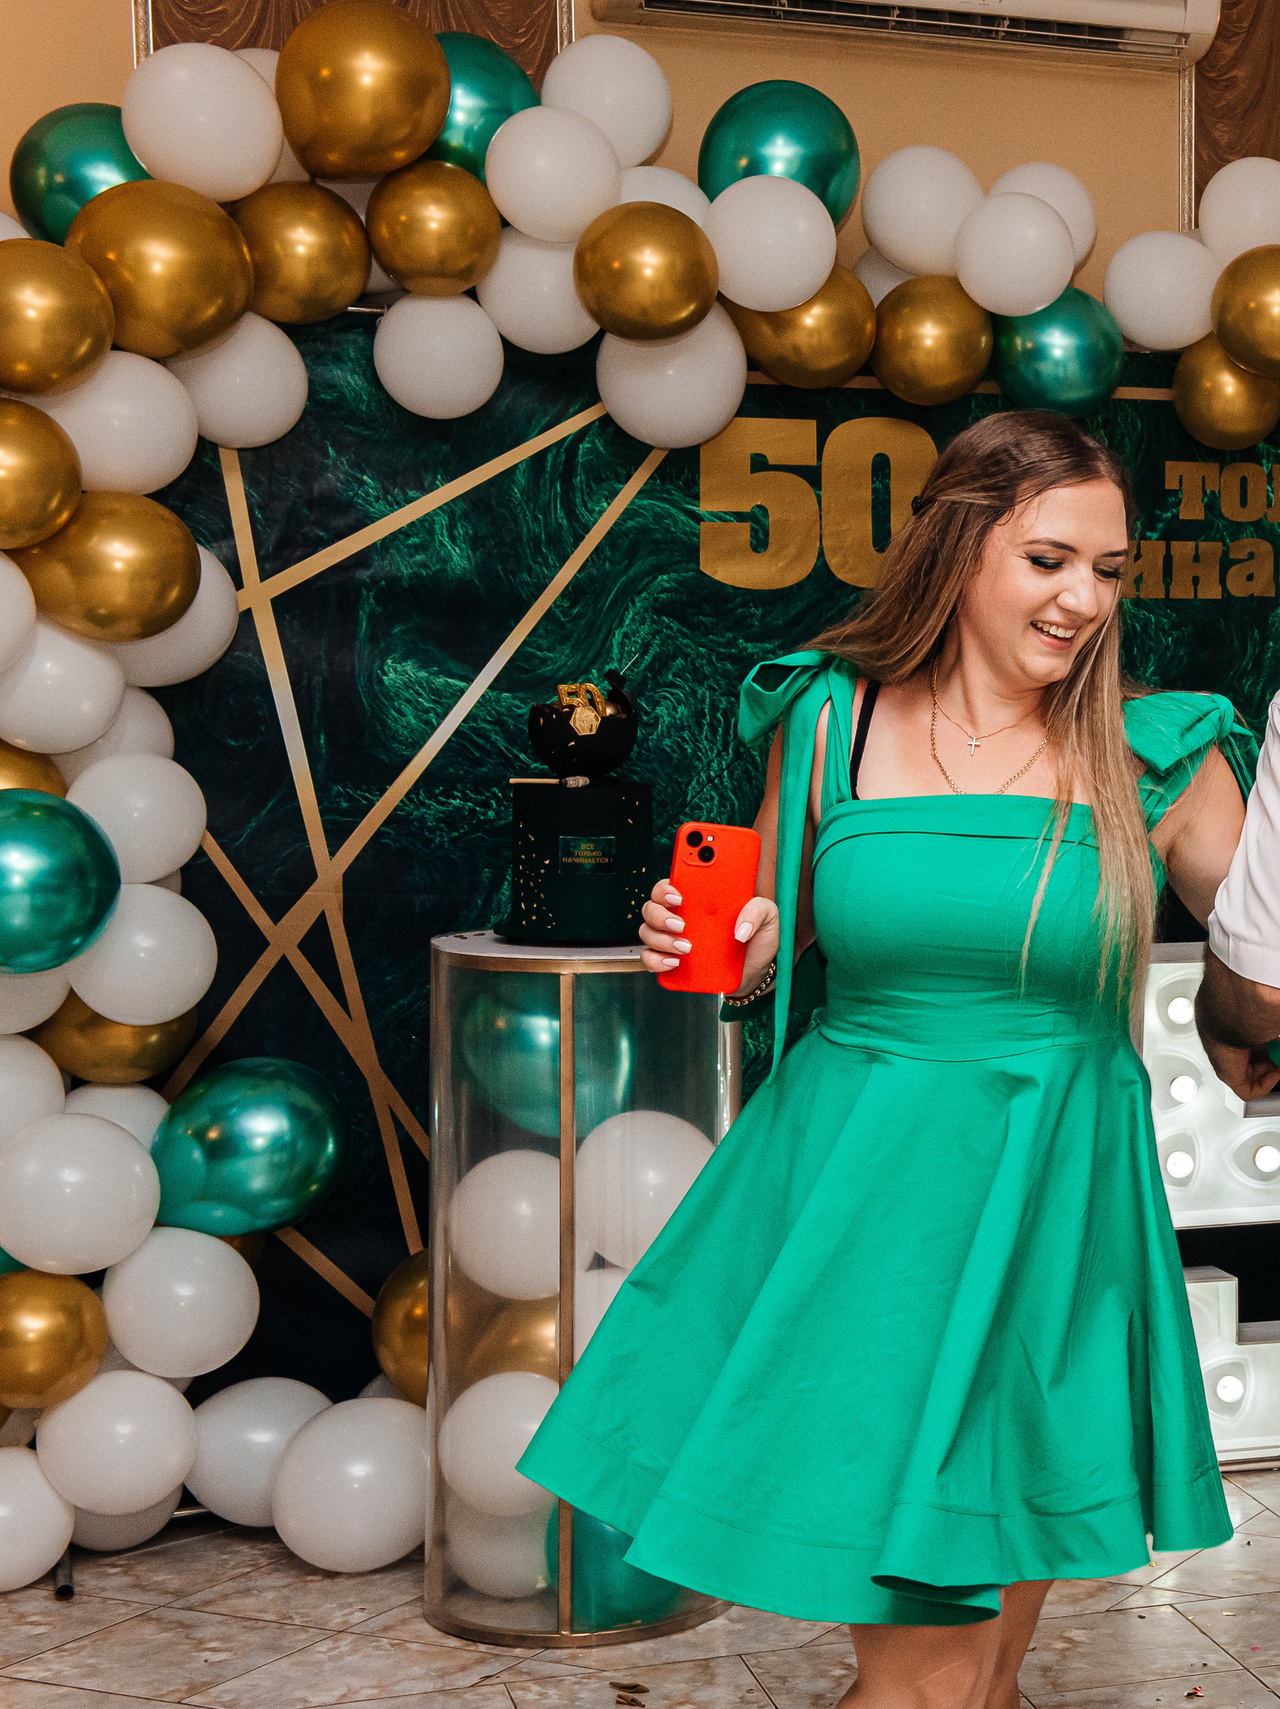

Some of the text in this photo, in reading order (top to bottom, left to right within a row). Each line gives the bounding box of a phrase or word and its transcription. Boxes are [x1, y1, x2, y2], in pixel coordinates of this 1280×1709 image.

[700, 417, 938, 590] 50
[557, 683, 607, 717] 50
[562, 856, 609, 864] НАЧИНАЕТСЯ
